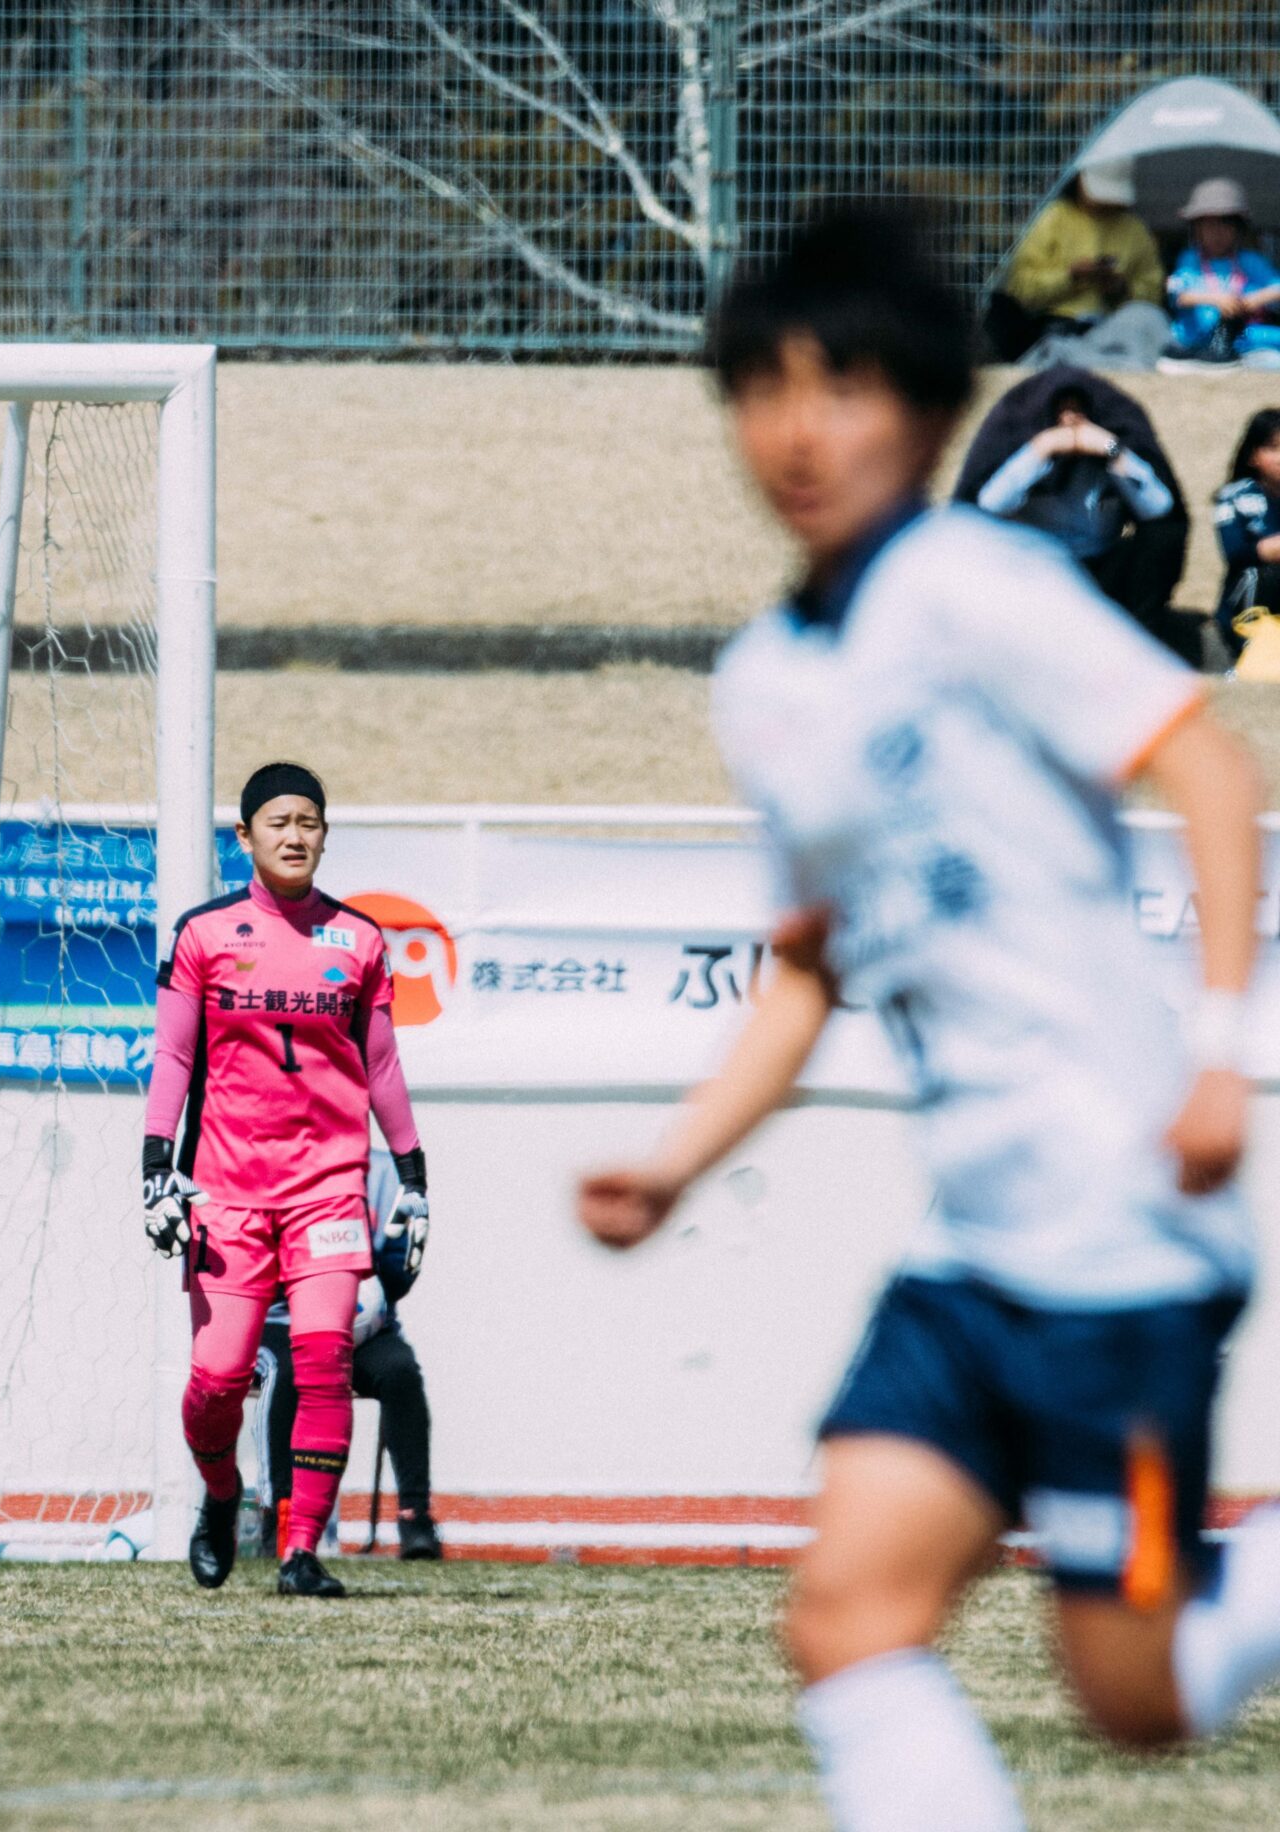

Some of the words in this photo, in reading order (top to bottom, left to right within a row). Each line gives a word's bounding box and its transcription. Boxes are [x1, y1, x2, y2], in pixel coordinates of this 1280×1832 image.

[471, 958, 627, 993] 株式会社
[275, 1023, 303, 1073] 1
[193, 1224, 211, 1274] 1
